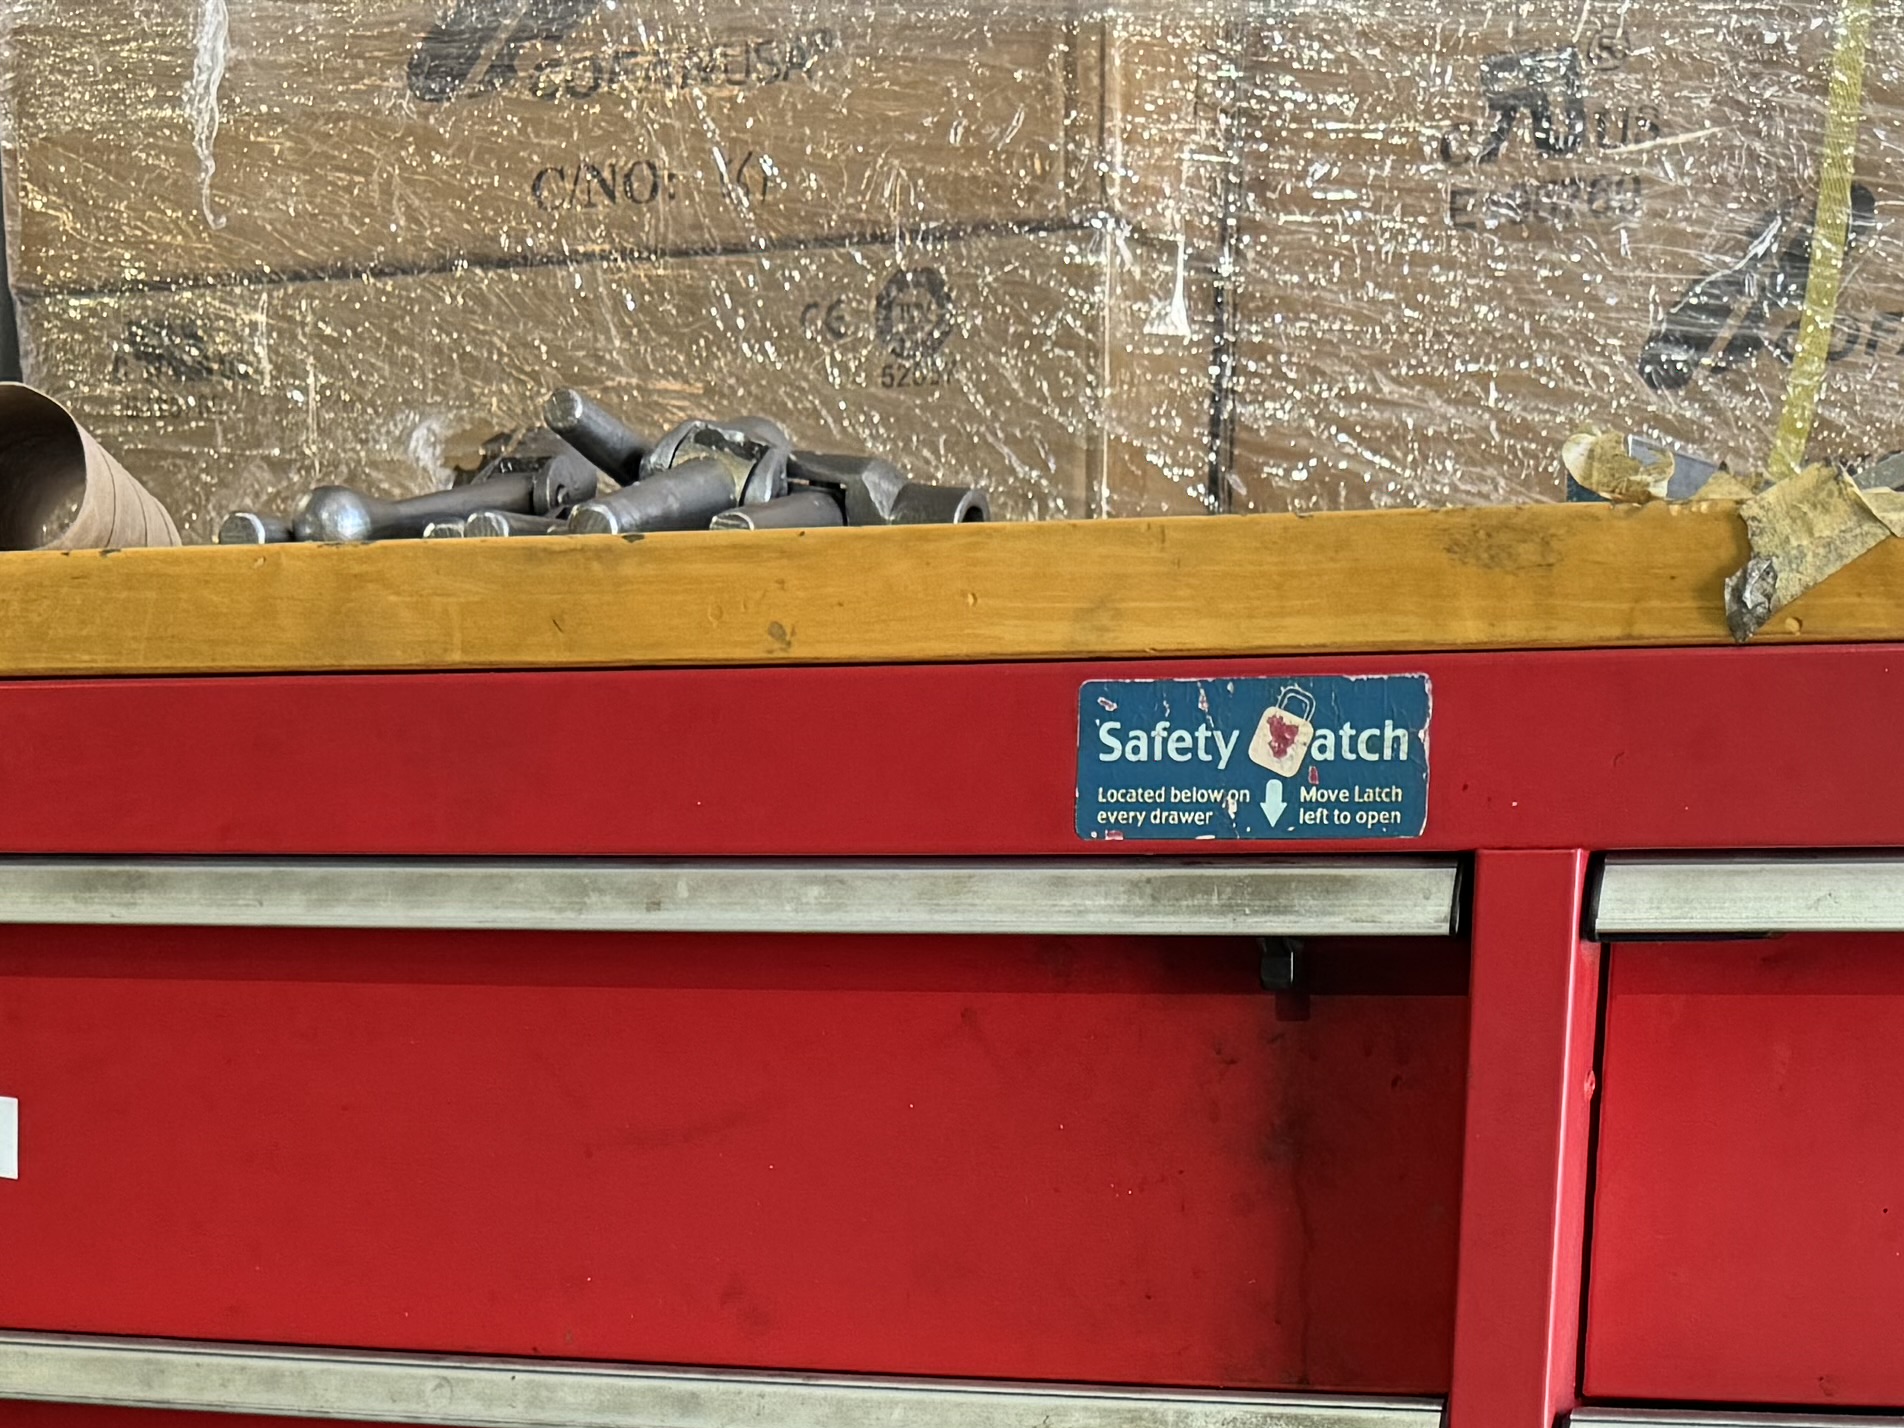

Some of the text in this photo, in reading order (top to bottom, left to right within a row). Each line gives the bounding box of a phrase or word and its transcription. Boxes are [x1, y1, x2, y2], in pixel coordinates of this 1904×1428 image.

[1097, 719, 1409, 770] Safety atch
[1097, 786, 1251, 803] Located below on
[1299, 785, 1403, 803] Move Latch
[1097, 808, 1214, 828] every drawer
[1299, 808, 1402, 830] left to open
